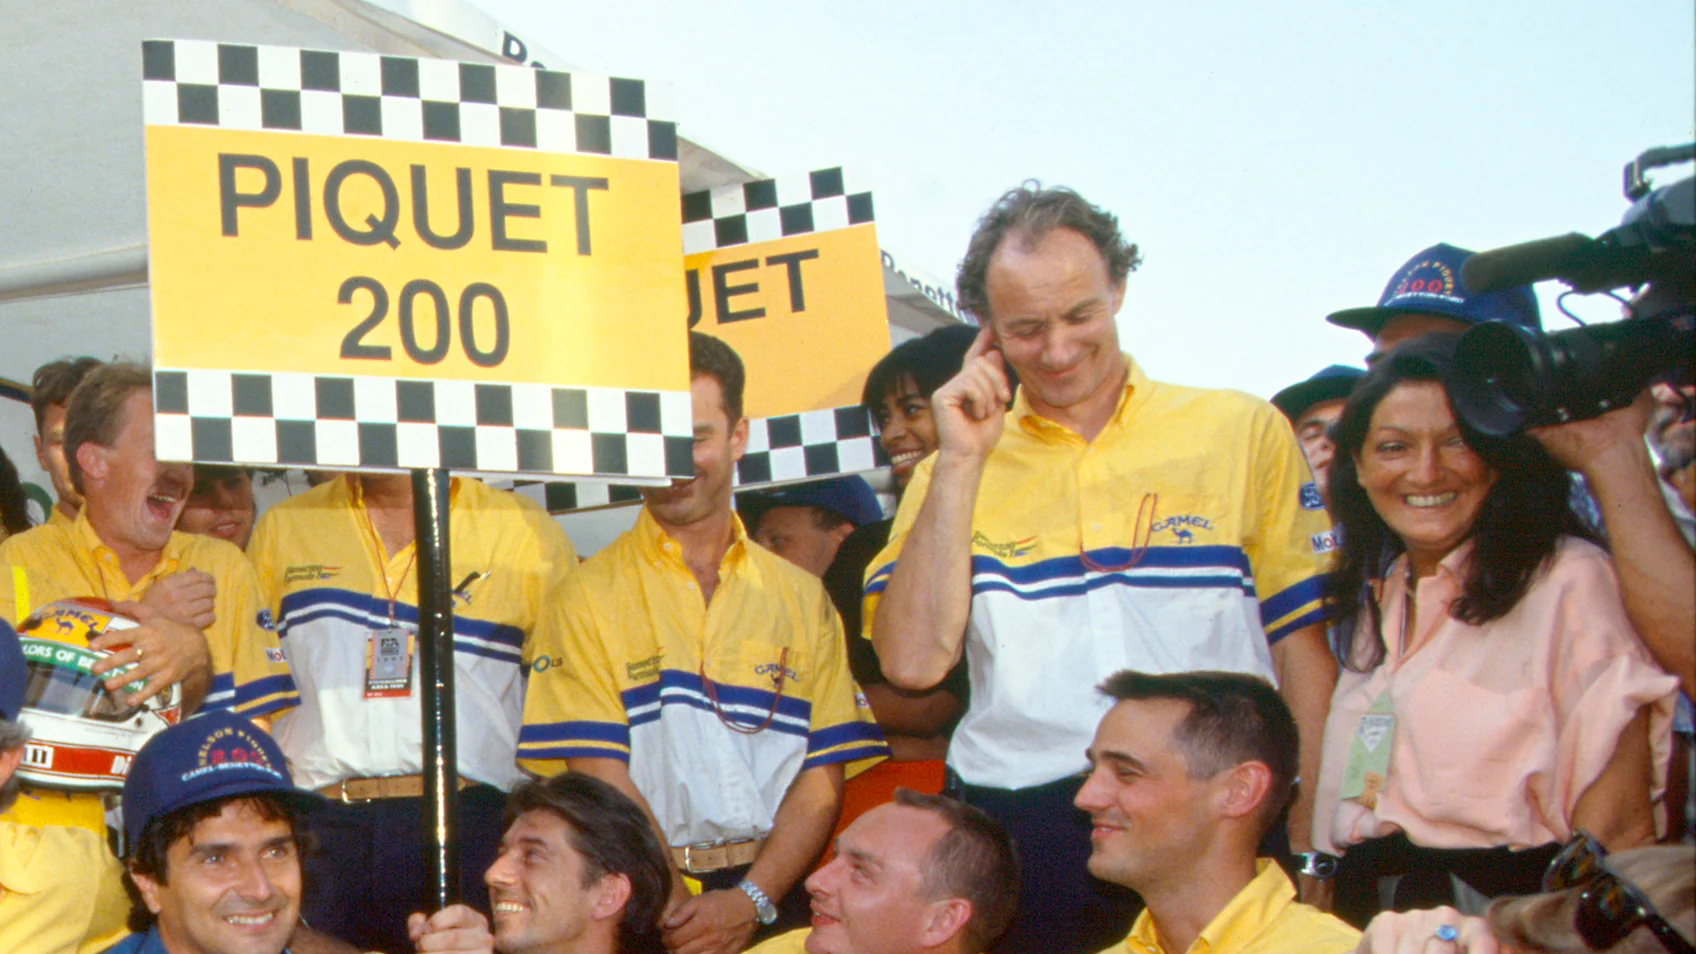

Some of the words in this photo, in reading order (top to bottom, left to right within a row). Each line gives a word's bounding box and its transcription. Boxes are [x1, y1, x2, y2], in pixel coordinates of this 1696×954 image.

[217, 152, 610, 257] PIQUET
[337, 274, 511, 369] 200
[1151, 515, 1214, 531] CAMEL
[55, 647, 77, 663] OF
